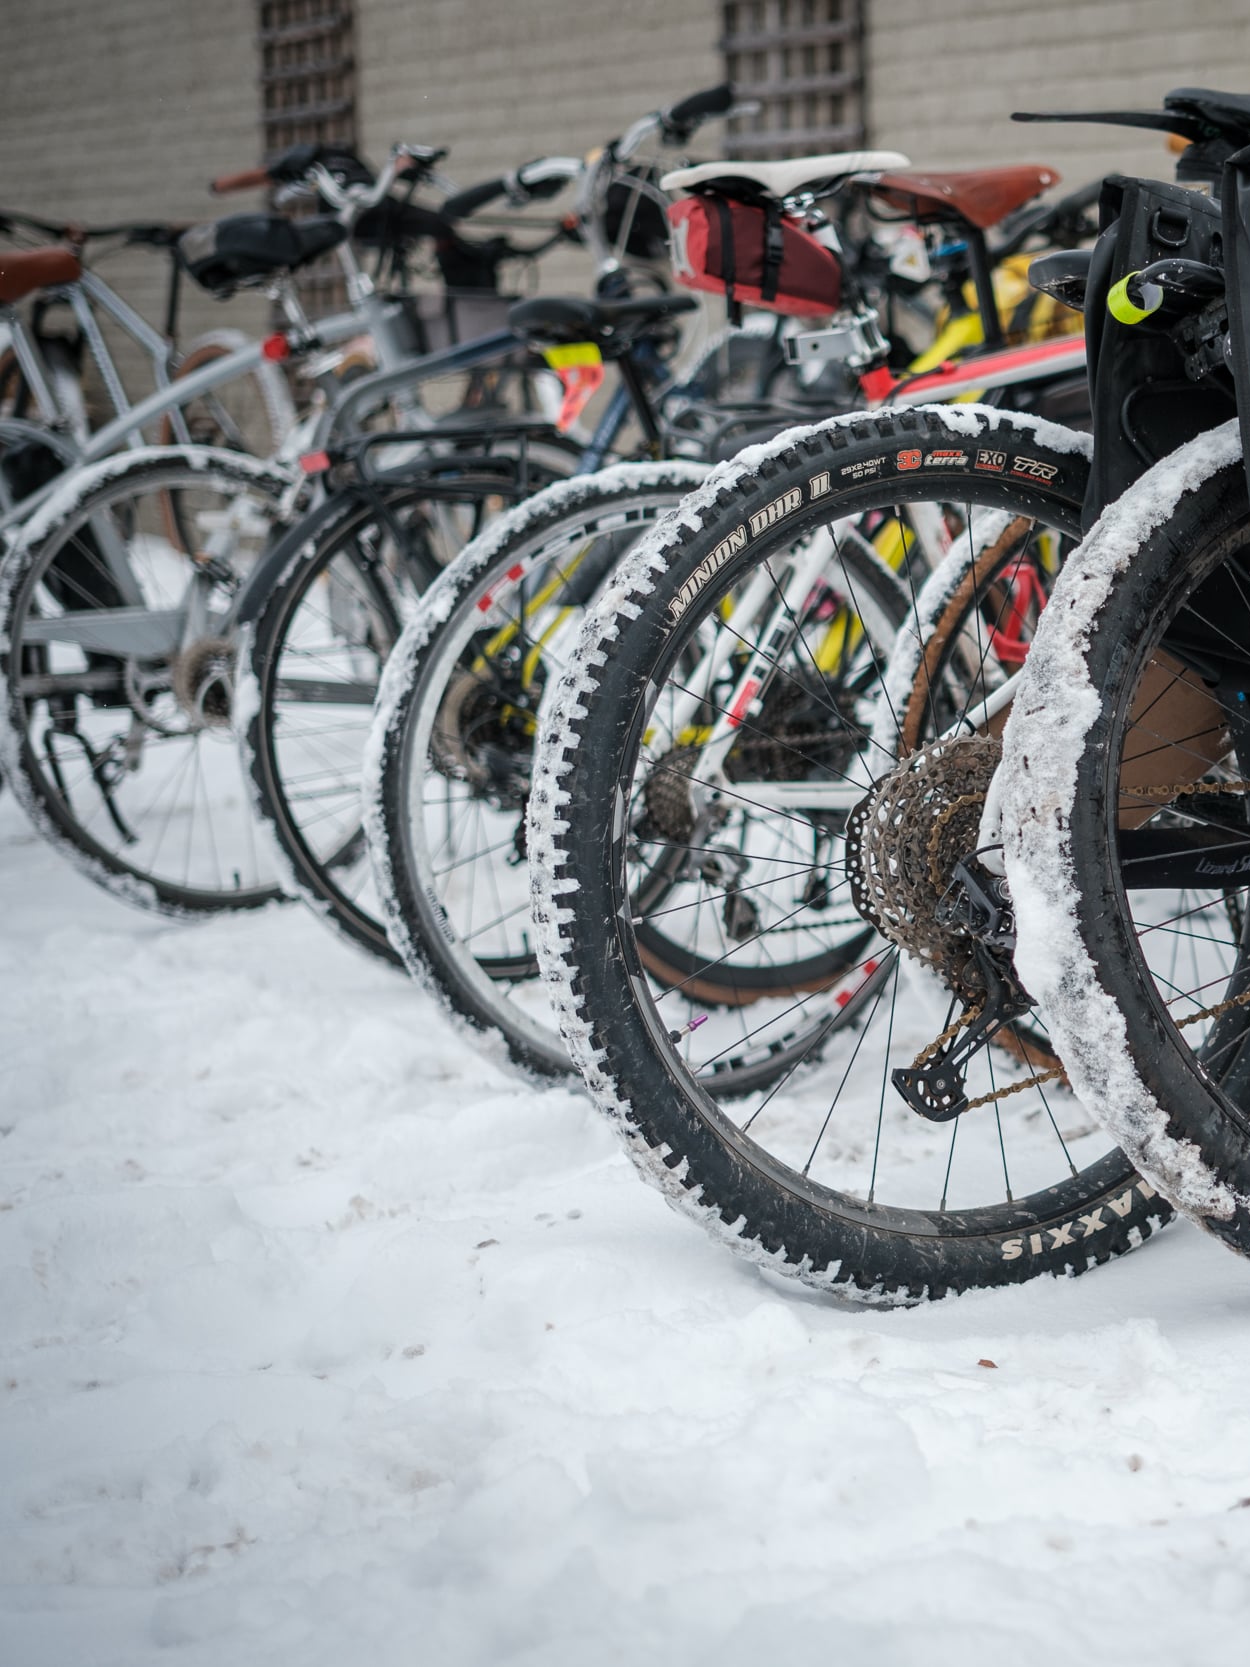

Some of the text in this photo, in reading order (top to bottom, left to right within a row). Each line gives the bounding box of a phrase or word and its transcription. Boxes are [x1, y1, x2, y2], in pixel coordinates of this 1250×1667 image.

[924, 454, 968, 466] terra
[976, 451, 1006, 466] EXO
[864, 468, 877, 476] PSI
[1013, 456, 1058, 480] TR
[669, 525, 748, 620] MINION
[749, 487, 802, 538] DHR
[1195, 856, 1239, 875] Lizard
